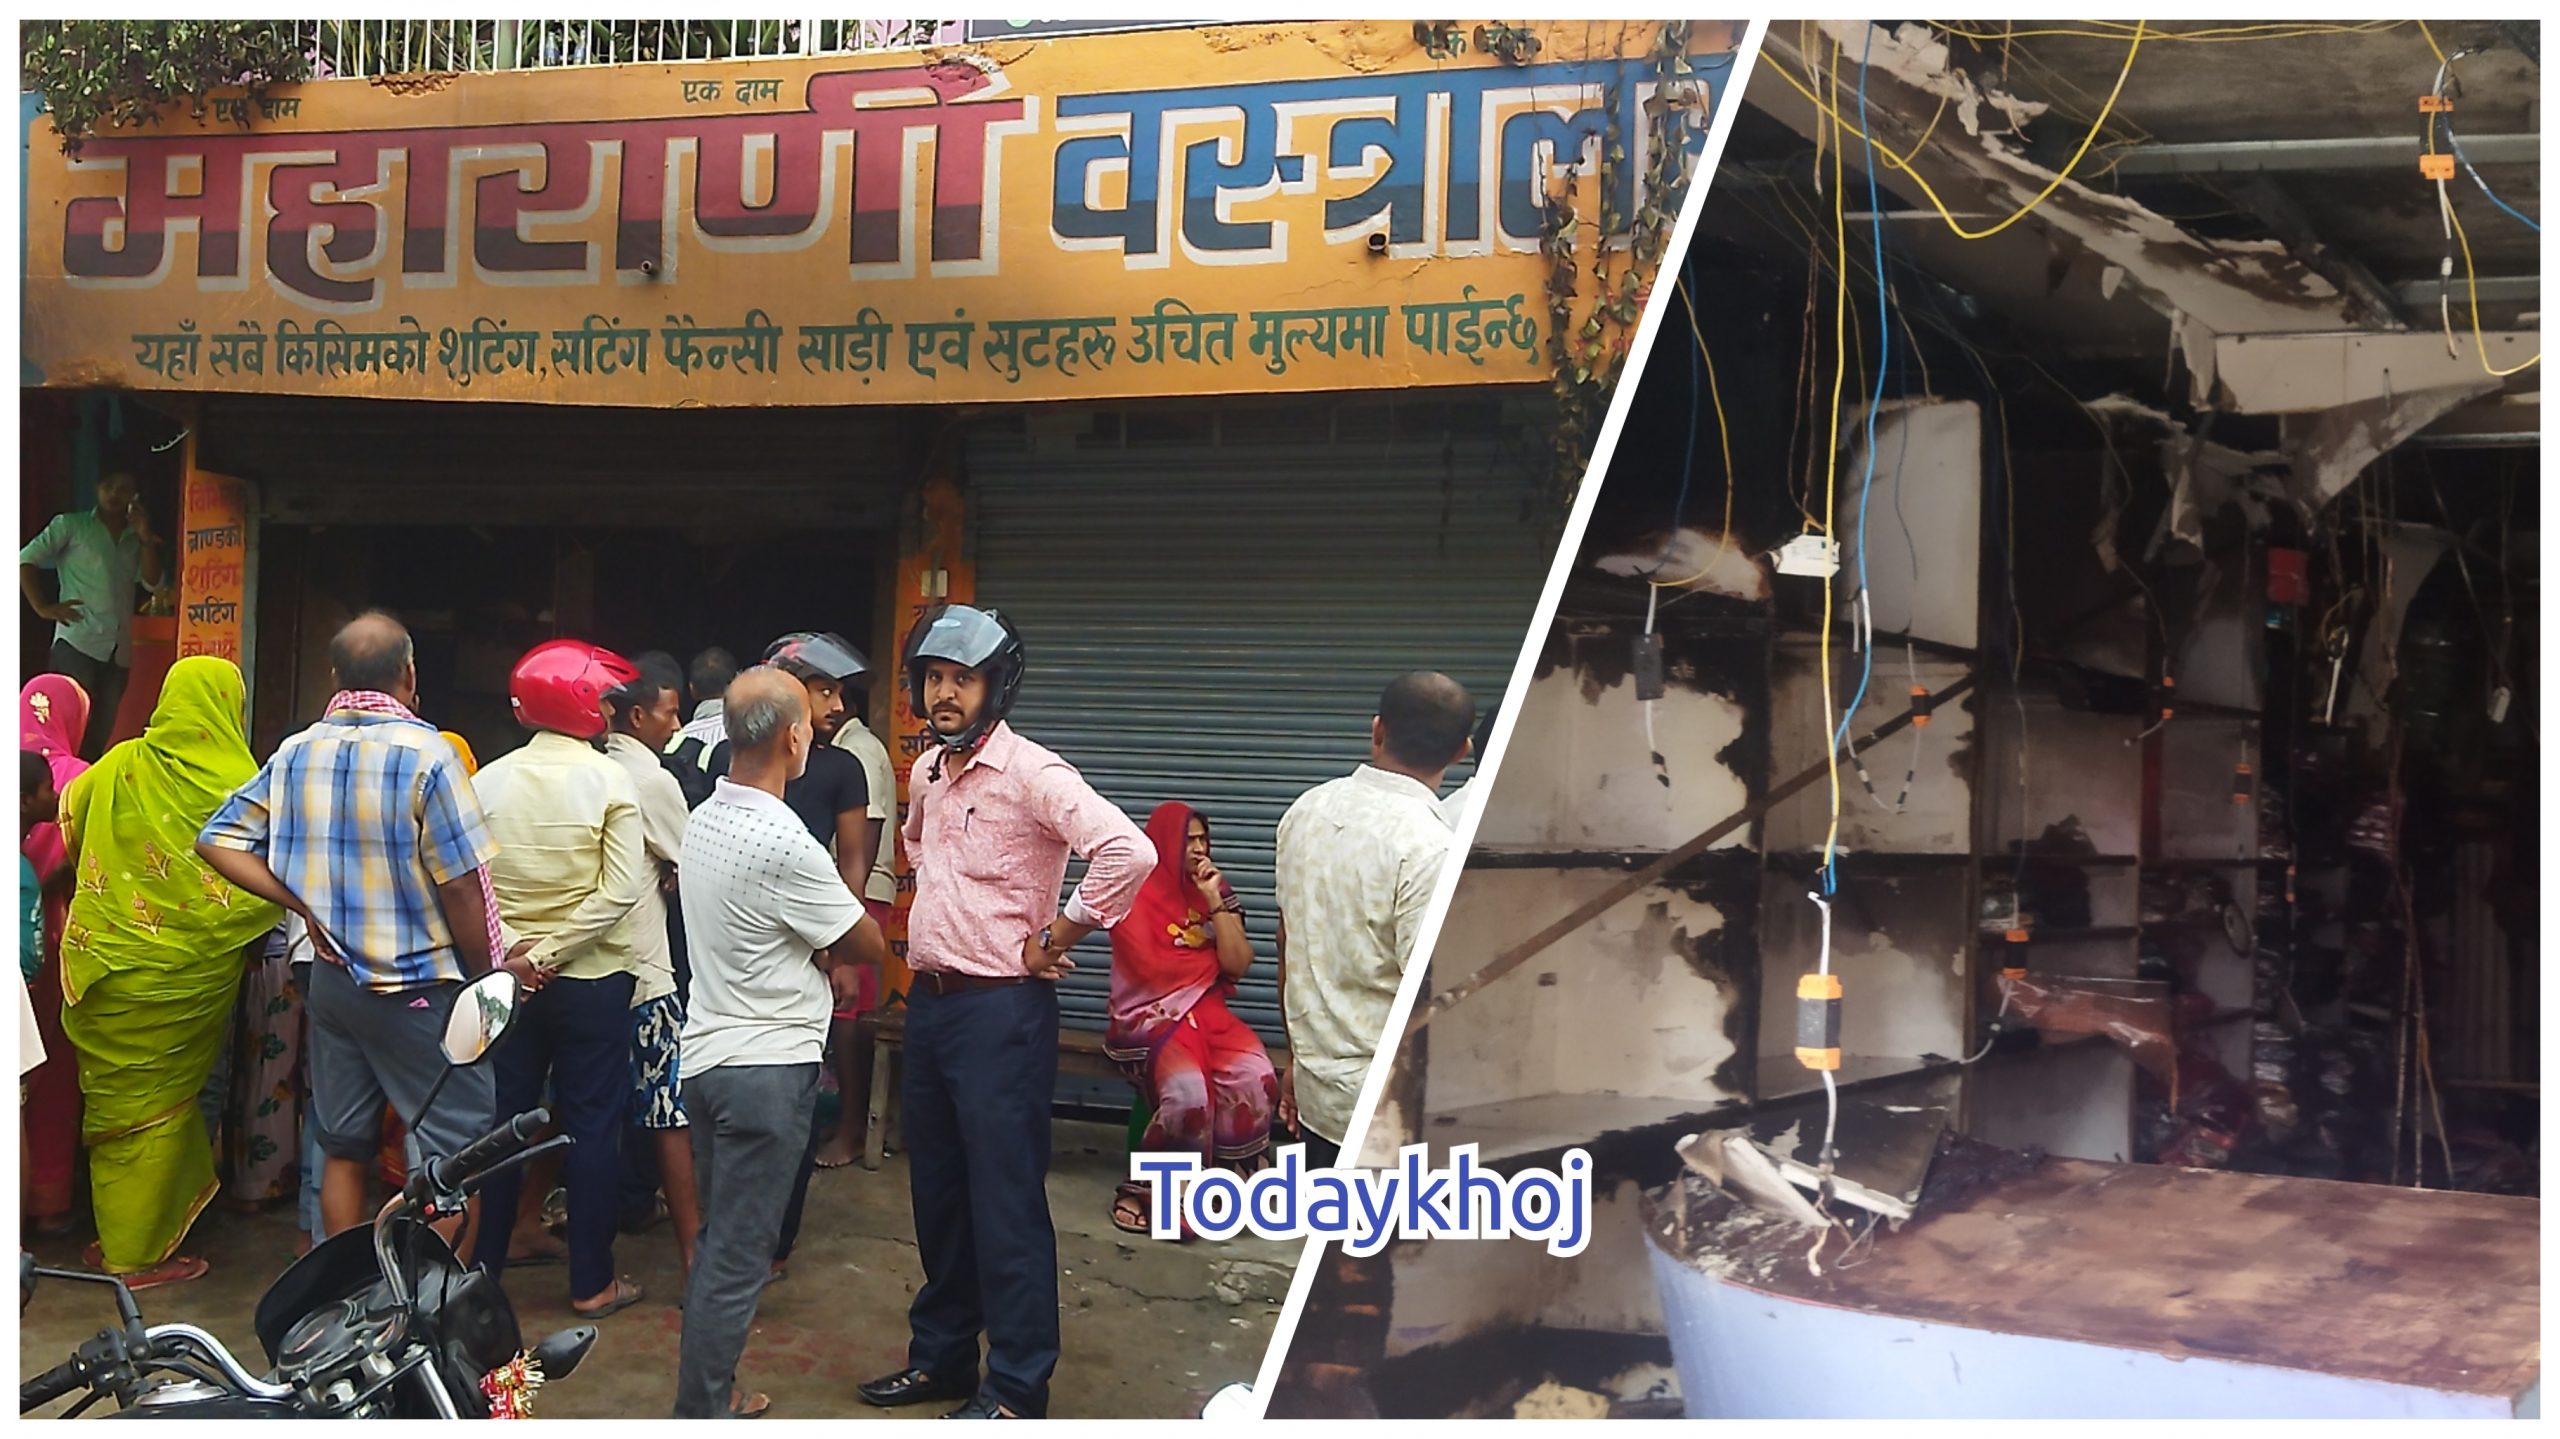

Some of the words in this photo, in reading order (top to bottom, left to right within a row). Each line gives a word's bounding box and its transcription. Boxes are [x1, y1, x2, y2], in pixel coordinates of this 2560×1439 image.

[680, 78, 722, 105] एक
[735, 77, 783, 105] दाम
[62, 62, 1038, 314] महाराणी
[131, 318, 202, 382] यहाँ
[274, 315, 431, 379] किसिमको
[797, 307, 894, 385] साड़ी
[903, 307, 976, 381] एवं
[1126, 297, 1239, 366] उचित
[1248, 305, 1391, 375] मुल्यमा
